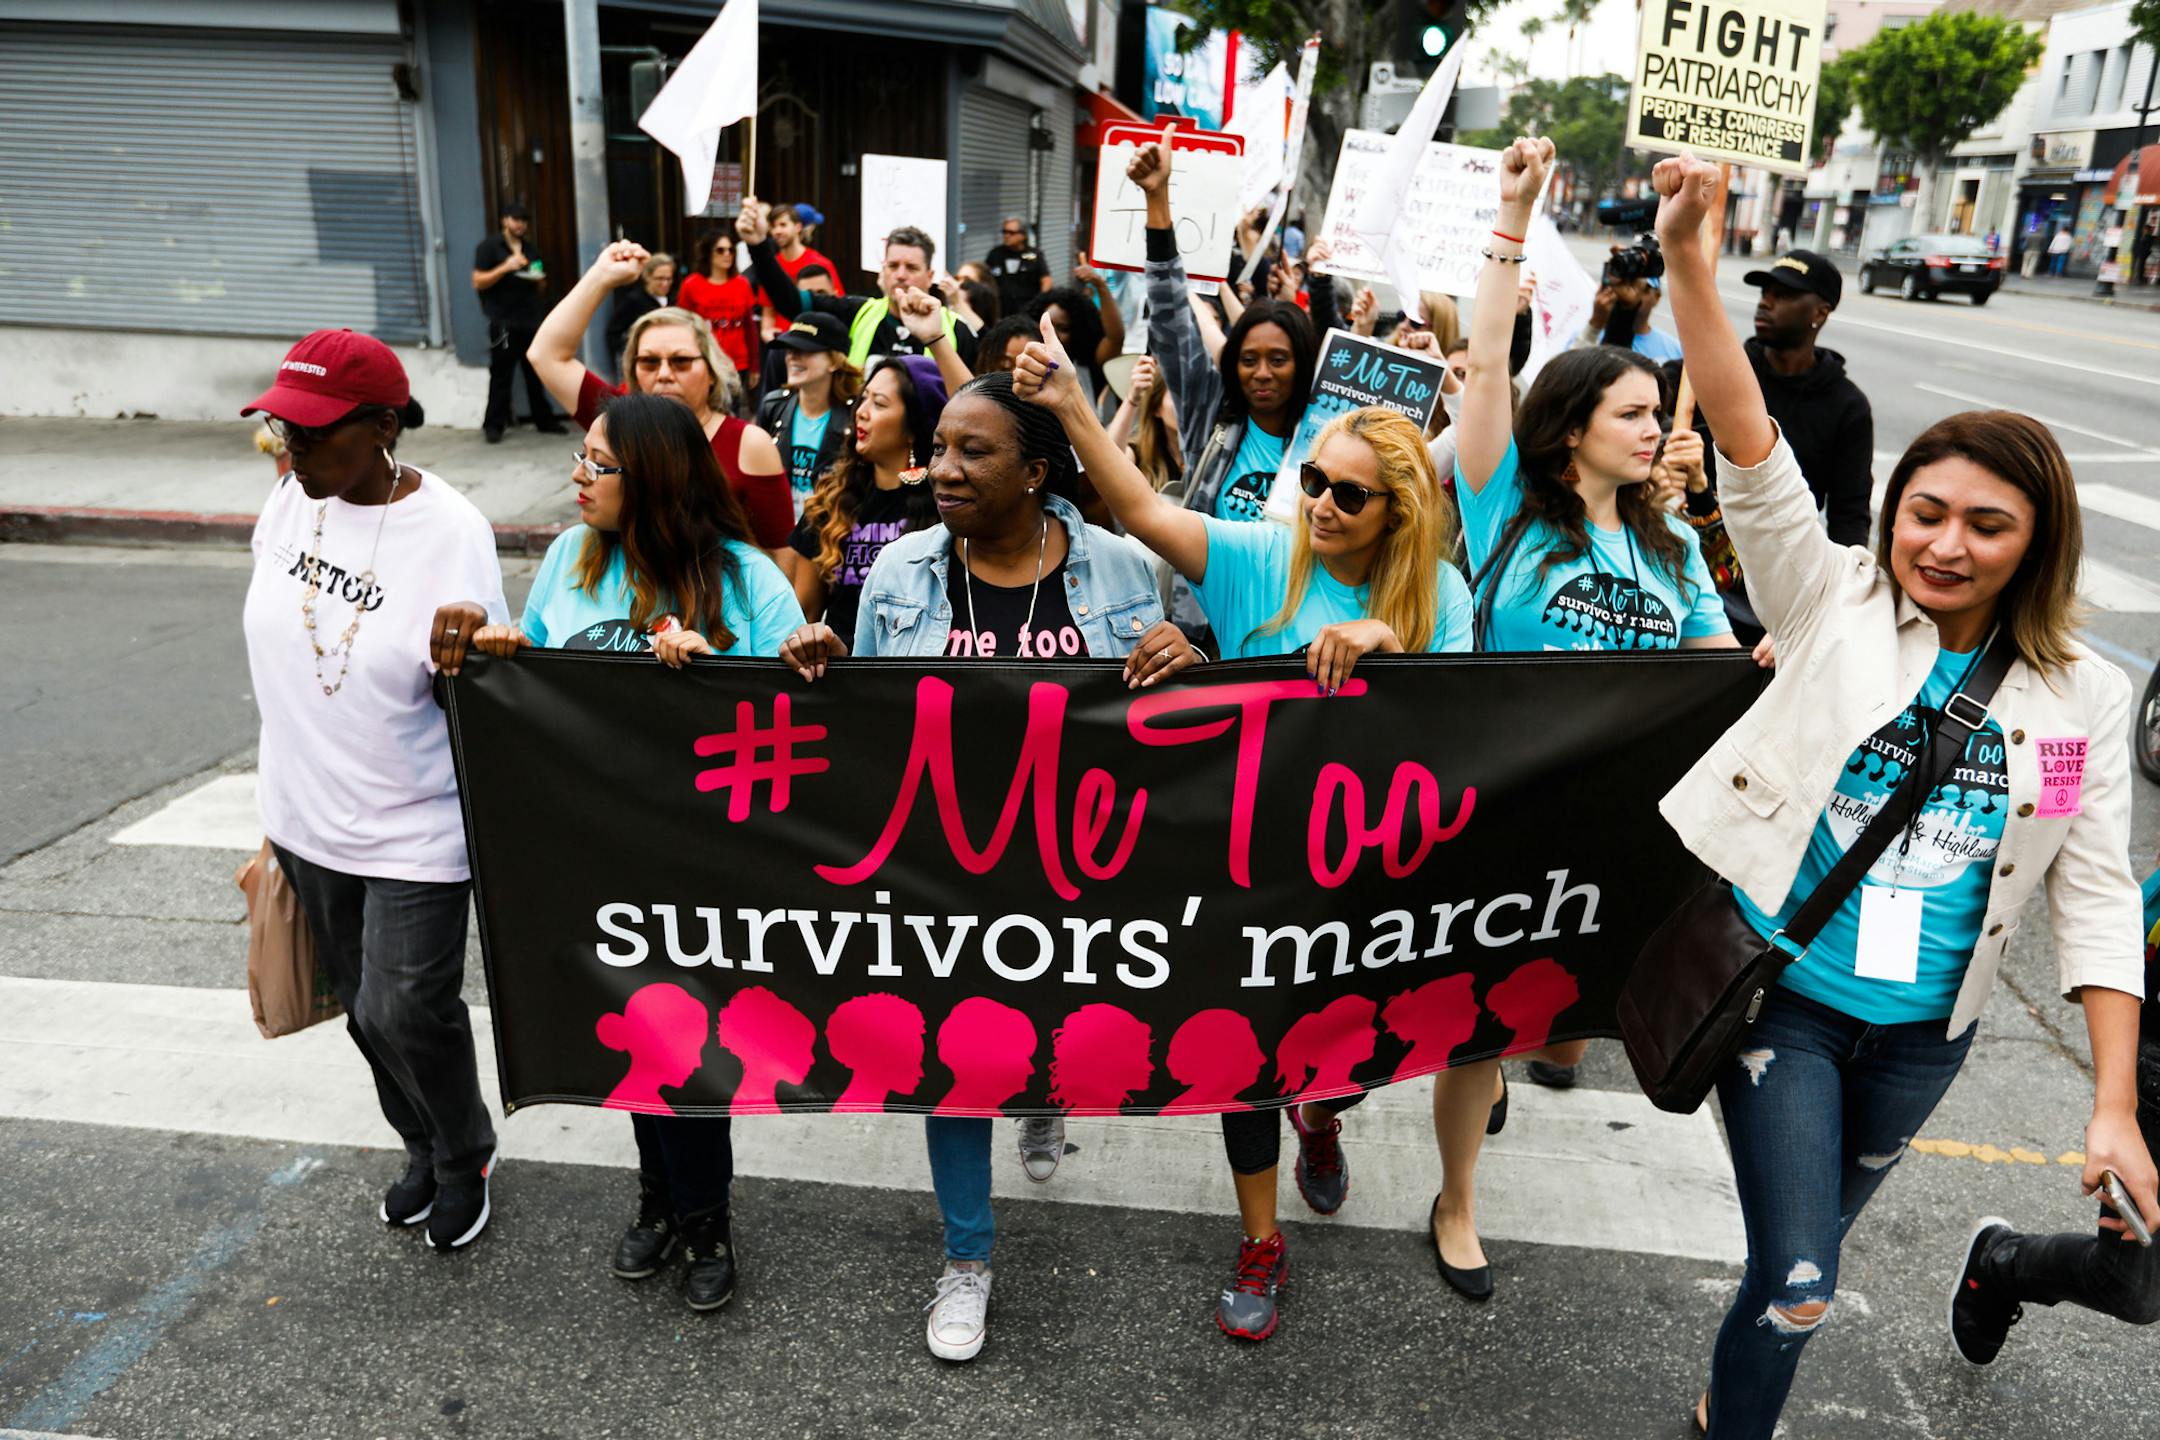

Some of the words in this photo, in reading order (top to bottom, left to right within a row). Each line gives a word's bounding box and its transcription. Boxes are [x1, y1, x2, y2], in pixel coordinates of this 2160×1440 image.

[1662, 0, 1810, 72] FIGHT
[1643, 53, 1811, 115] PATRIARCHY
[1642, 97, 1723, 128] PEOPLE'S
[1725, 110, 1803, 143] CONGRESS
[1663, 120, 1686, 141] OF
[1688, 125, 1783, 158] RESISTANCE
[1383, 398, 1425, 420] march
[948, 629, 997, 657] me
[2040, 742, 2087, 756] RISE
[2042, 760, 2084, 773] LOVE
[2044, 776, 2081, 786] RESIST
[596, 891, 1203, 989] survivors'
[1240, 869, 1601, 989] march
